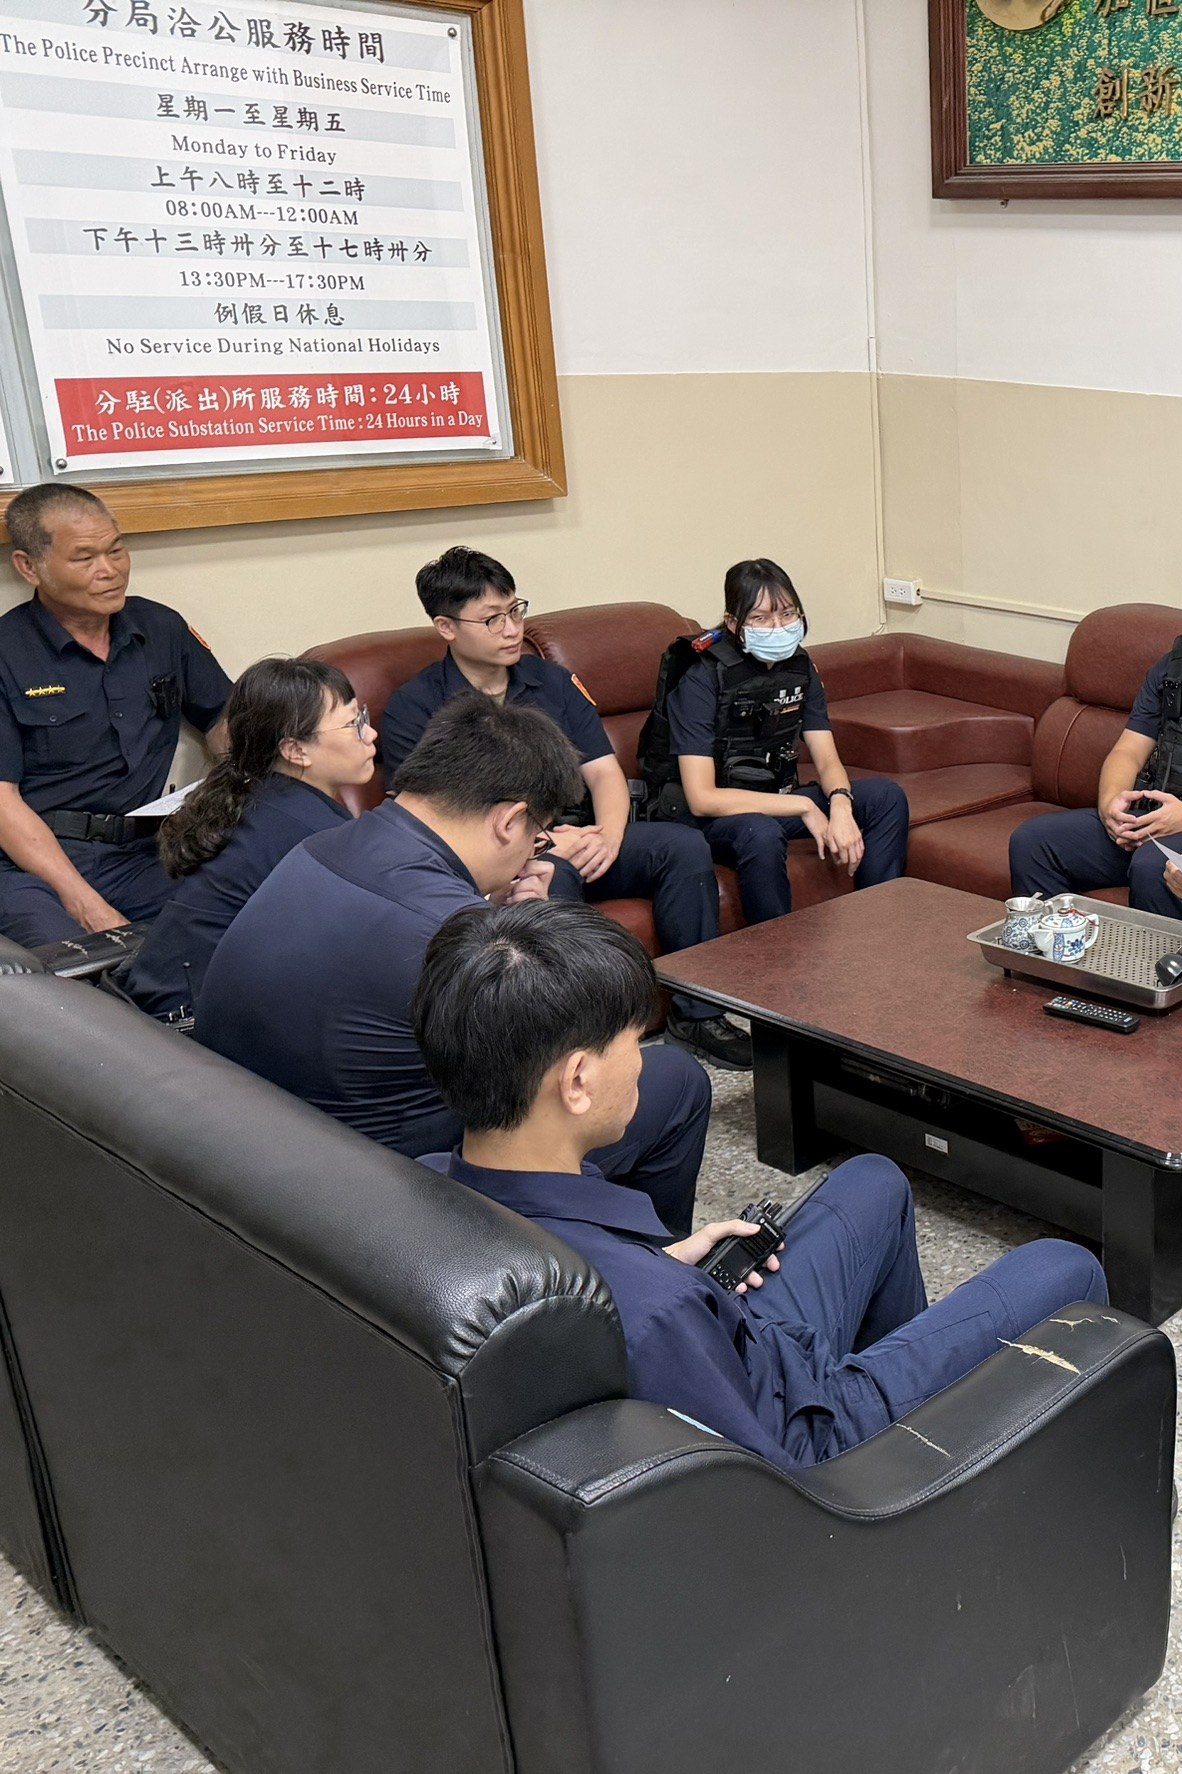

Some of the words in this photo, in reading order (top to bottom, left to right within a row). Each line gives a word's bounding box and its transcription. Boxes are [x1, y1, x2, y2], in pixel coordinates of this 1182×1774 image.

[83, 0, 385, 63] 分局洽公服務時間
[0, 33, 37, 56] The
[41, 38, 98, 63] Police
[102, 46, 176, 72] Precinct
[181, 57, 248, 82] Arrange
[252, 66, 289, 85] with
[293, 69, 357, 93] Business
[361, 77, 412, 99] Service
[415, 84, 451, 103] Time
[156, 93, 346, 132] 星期一至星期五
[171, 135, 248, 158] Monday
[255, 143, 272, 158] to
[277, 144, 337, 165] Friday
[150, 165, 365, 201] 上午八時至十二時
[213, 302, 345, 326] 例假日休息
[106, 338, 134, 354] No
[140, 337, 212, 354] Service
[217, 338, 284, 355] During
[289, 337, 363, 353] National
[368, 337, 440, 354] Holidays
[72, 424, 107, 442] The
[112, 420, 164, 440] Police
[168, 418, 254, 438] Substation
[258, 416, 314, 433] Service
[386, 412, 427, 428] Hours
[431, 411, 444, 427] in
[448, 415, 455, 426] a
[458, 410, 483, 428] Day
